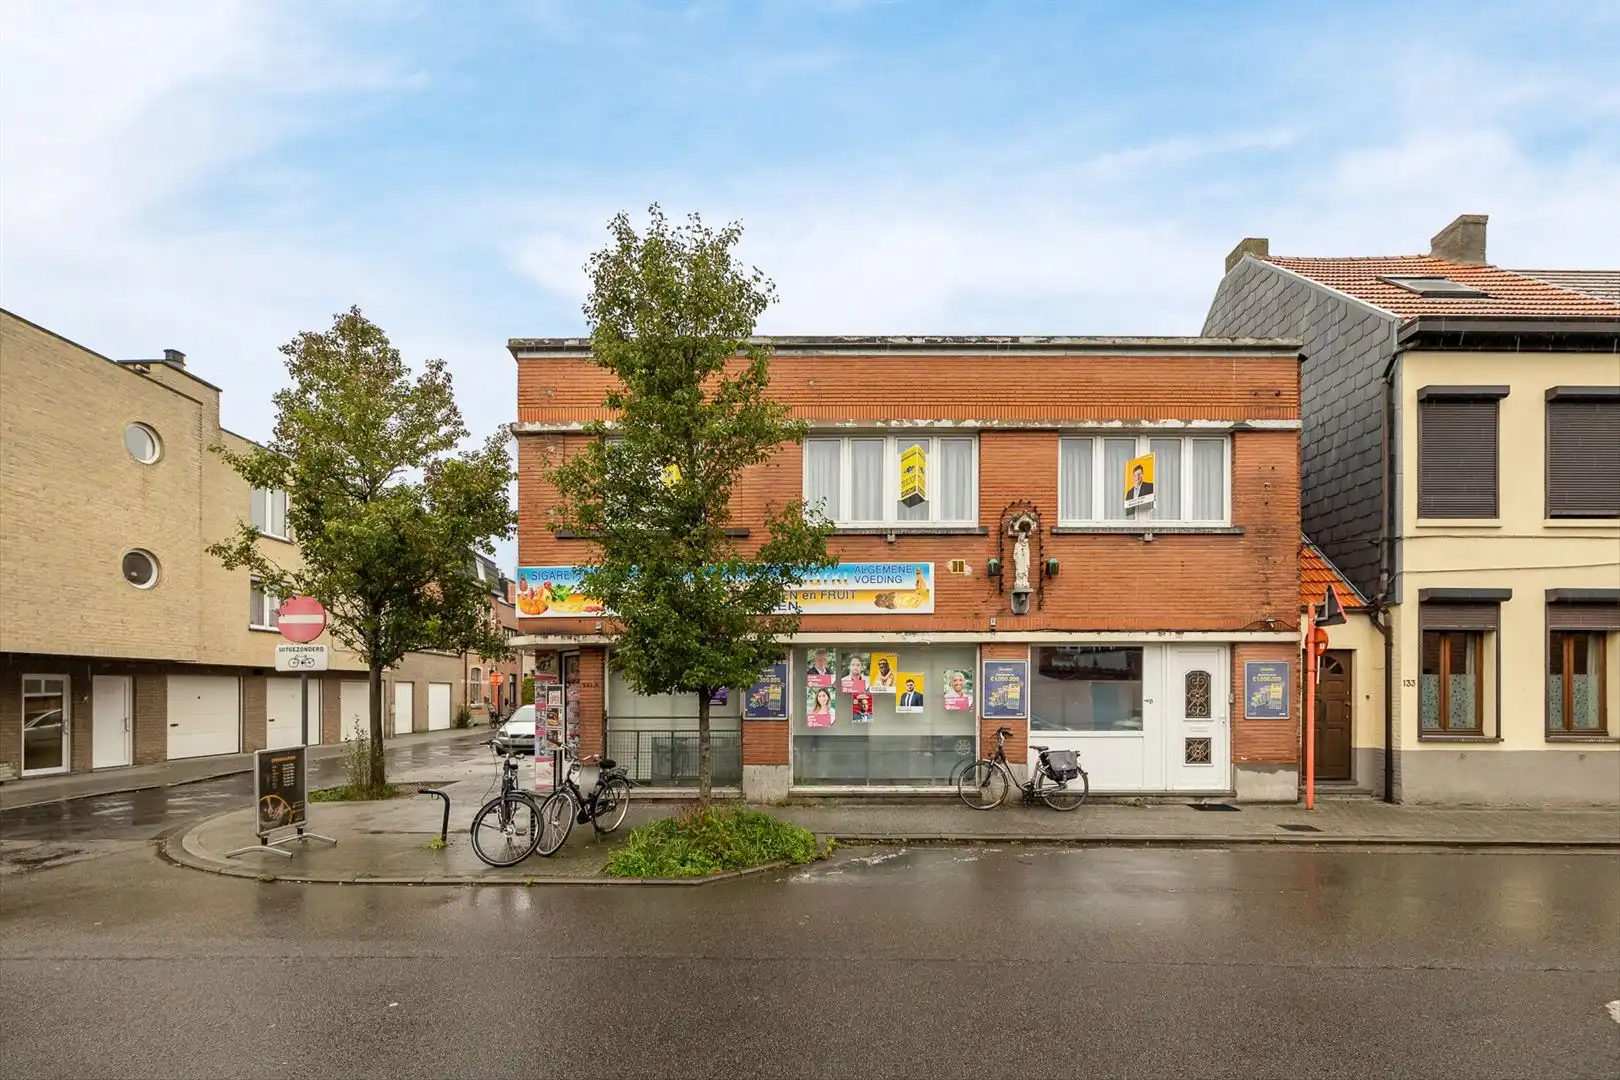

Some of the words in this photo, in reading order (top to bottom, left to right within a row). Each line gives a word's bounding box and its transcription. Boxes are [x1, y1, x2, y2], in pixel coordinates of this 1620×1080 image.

[854, 564, 912, 575] ALGEMENE
[854, 575, 903, 584] VOEDING
[802, 592, 816, 600] en
[820, 589, 857, 600] FRUIT
[1403, 679, 1416, 687] 133
